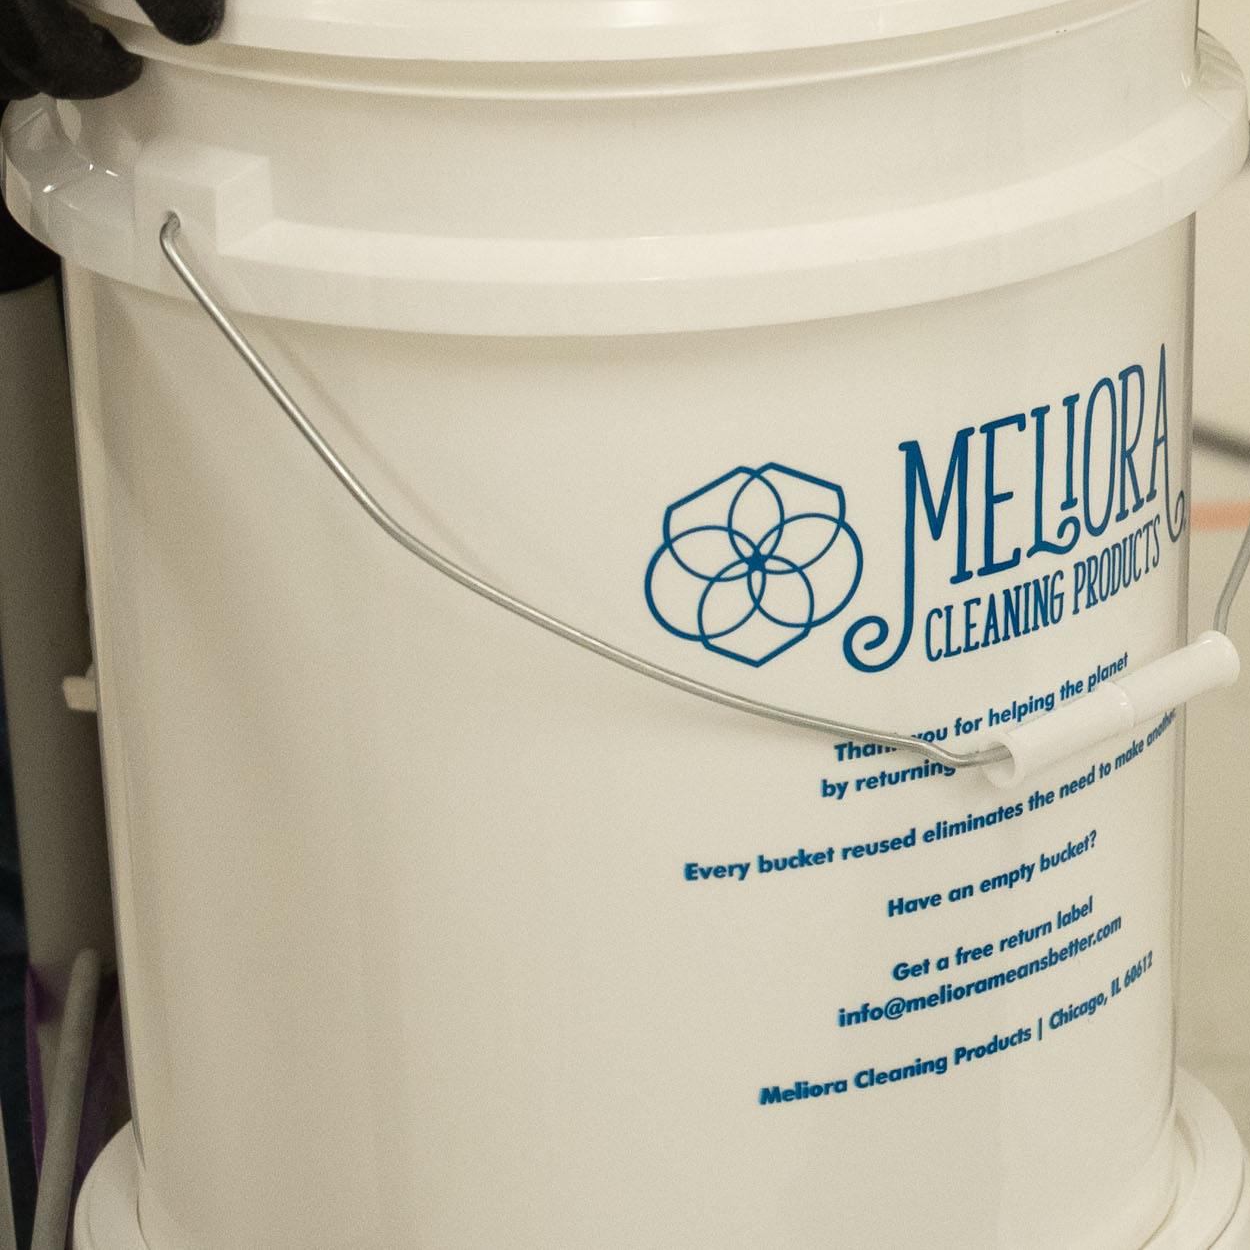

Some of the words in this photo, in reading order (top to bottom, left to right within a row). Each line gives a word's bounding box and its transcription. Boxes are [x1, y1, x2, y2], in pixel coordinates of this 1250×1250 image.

[841, 347, 1184, 674] MELIORA
[924, 570, 1064, 662] CLEANING
[1072, 515, 1160, 616] PRODUCTS
[833, 742, 896, 762] Tha
[954, 718, 983, 737] for
[988, 692, 1056, 725] helping
[1058, 680, 1084, 702] the
[1087, 651, 1130, 692] planet
[683, 862, 751, 882] Every
[756, 847, 835, 874] bucket
[840, 827, 917, 861] reused
[921, 802, 1023, 844] eliminates
[1027, 790, 1056, 812] the
[1059, 766, 1096, 798] need
[1098, 762, 1112, 778] to
[1114, 742, 1144, 770] make
[820, 779, 848, 801] by
[886, 894, 942, 918] Have
[947, 884, 974, 902] an
[978, 863, 1035, 894] empty
[1038, 830, 1096, 873] bucket?
[837, 917, 1121, 1030] info@meliorameansbetter.com
[890, 958, 931, 982] Get
[934, 958, 949, 971] a
[954, 943, 994, 966] free
[998, 921, 1053, 953] return
[1056, 895, 1093, 930] label
[757, 1079, 848, 1106] Meliora
[852, 1056, 948, 1089] Cleaning
[952, 1027, 1032, 1066] Products
[1048, 993, 1108, 1030] Chicago,
[1110, 978, 1121, 998] IL
[1123, 952, 1152, 989] 60612
